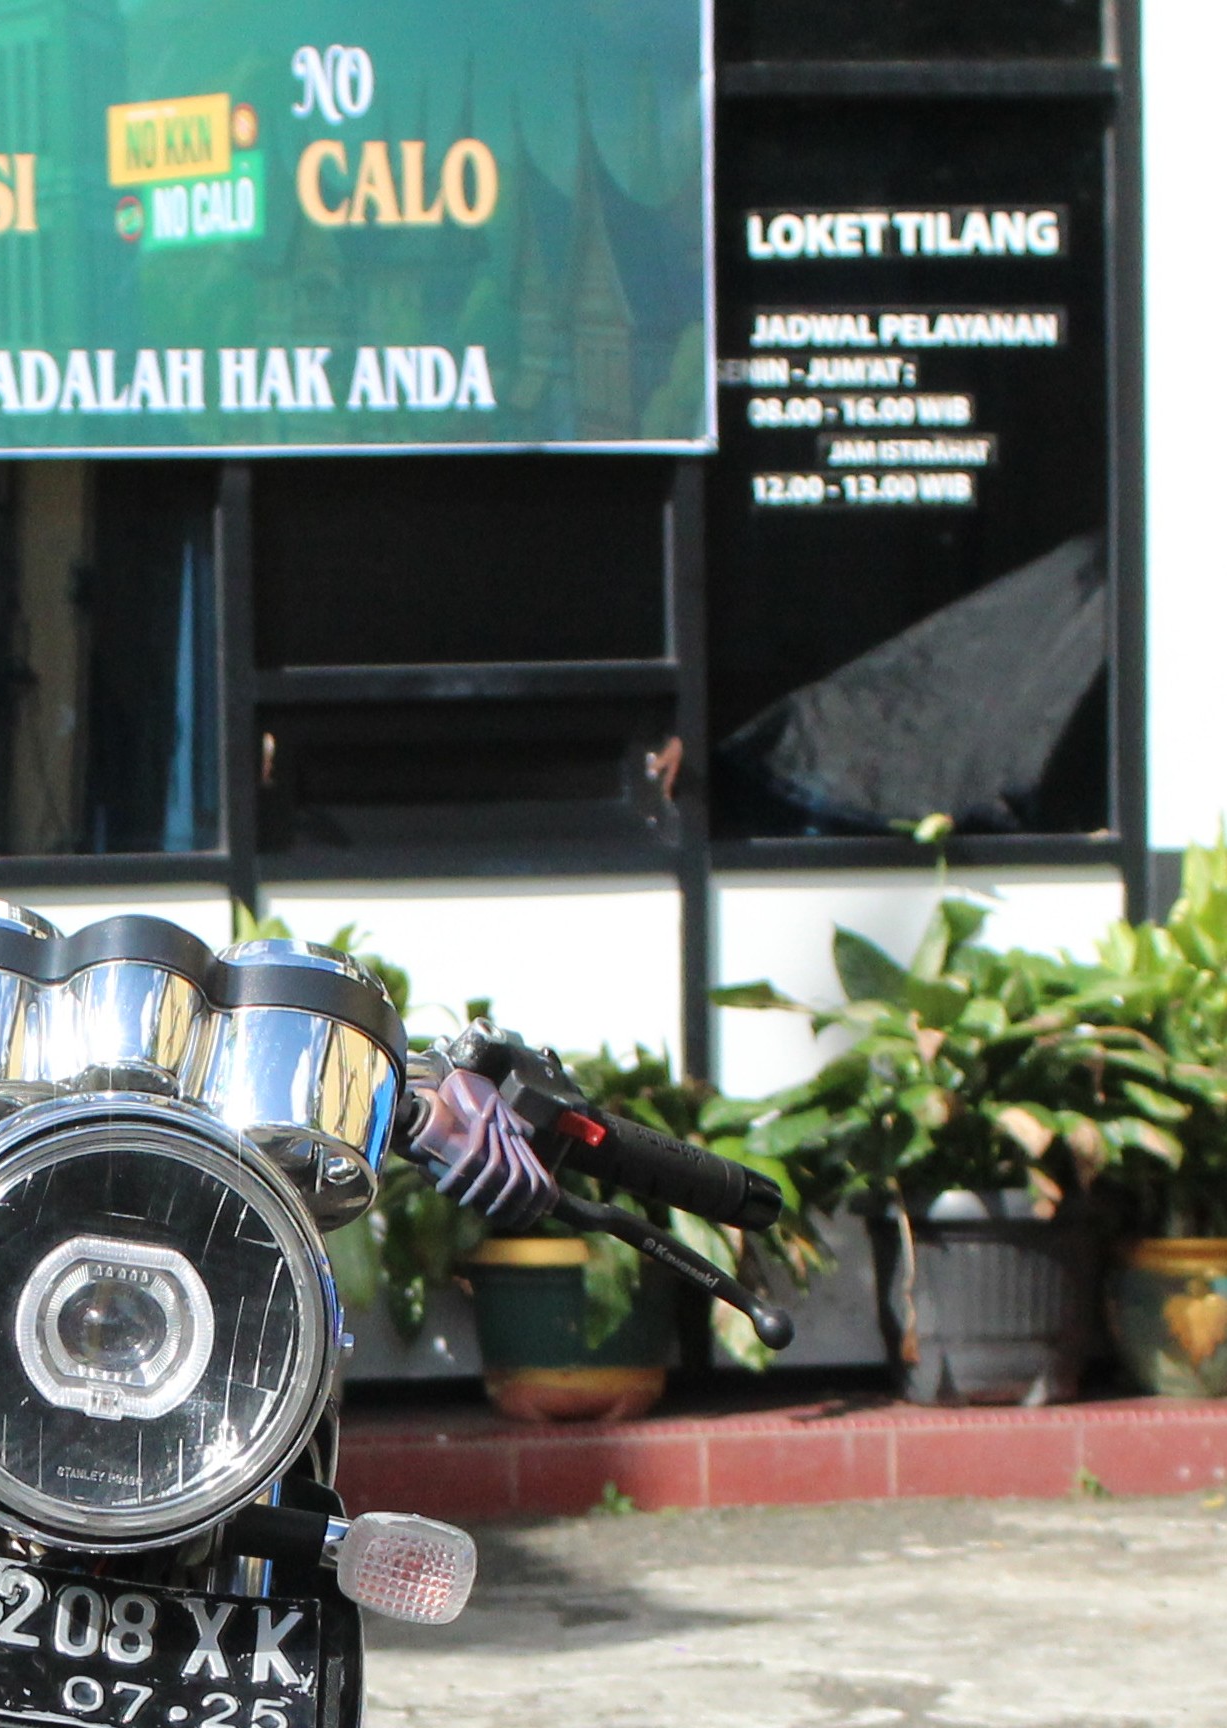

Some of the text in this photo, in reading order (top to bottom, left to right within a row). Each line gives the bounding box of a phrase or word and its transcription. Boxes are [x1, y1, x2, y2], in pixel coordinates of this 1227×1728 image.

[292, 45, 372, 124] NO
[153, 175, 255, 241] NO CALO
[297, 138, 498, 227] CALO
[746, 210, 1060, 260] LOKET TILANG
[749, 312, 1059, 348] JADWAL PELAYANAN
[219, 347, 334, 411] HAK
[348, 346, 496, 410] ANDA
[840, 395, 916, 427] 16.00
[915, 393, 972, 427] WIB
[751, 474, 825, 505] 12.00
[916, 471, 973, 504] WIB
